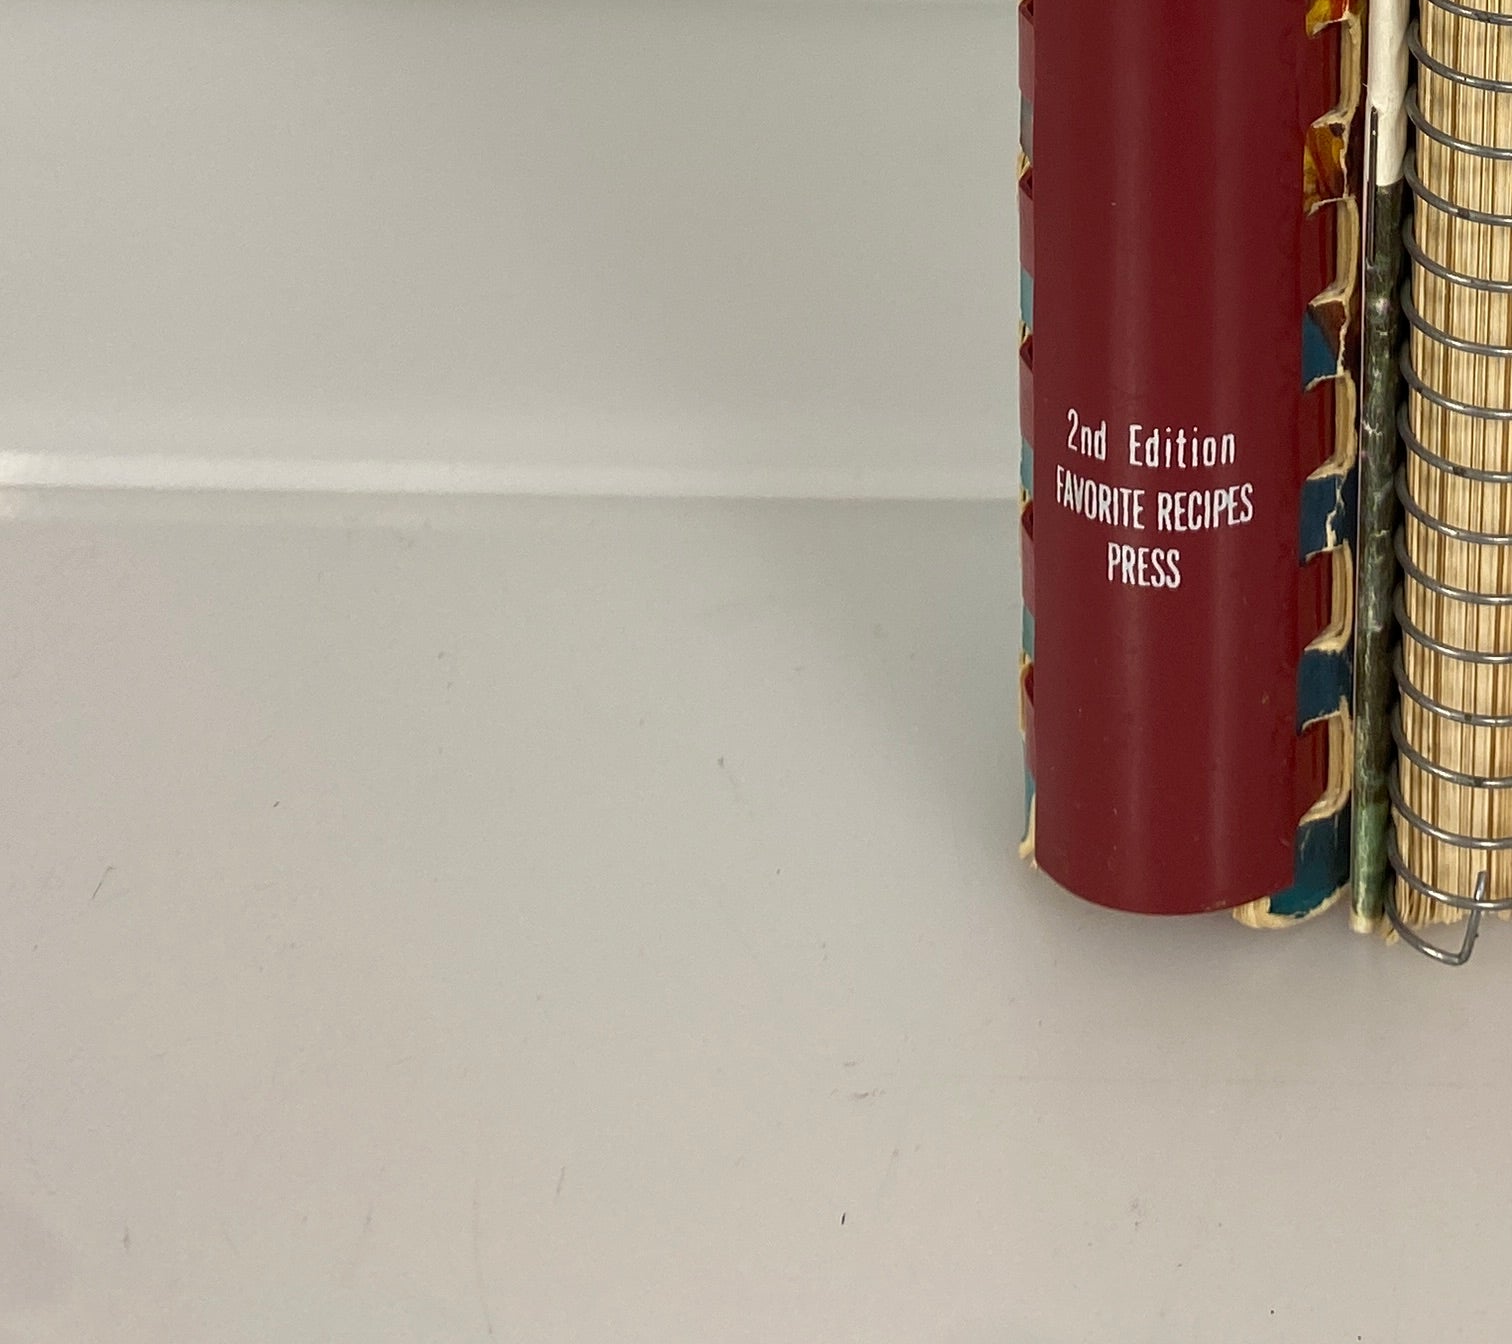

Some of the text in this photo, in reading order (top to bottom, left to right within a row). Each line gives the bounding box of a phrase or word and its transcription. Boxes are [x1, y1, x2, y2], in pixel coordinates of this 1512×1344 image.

[1066, 407, 1236, 469] 2nd Edition
[1056, 464, 1254, 532] FAVORITE RECIPES
[1107, 542, 1181, 589] PRESS
